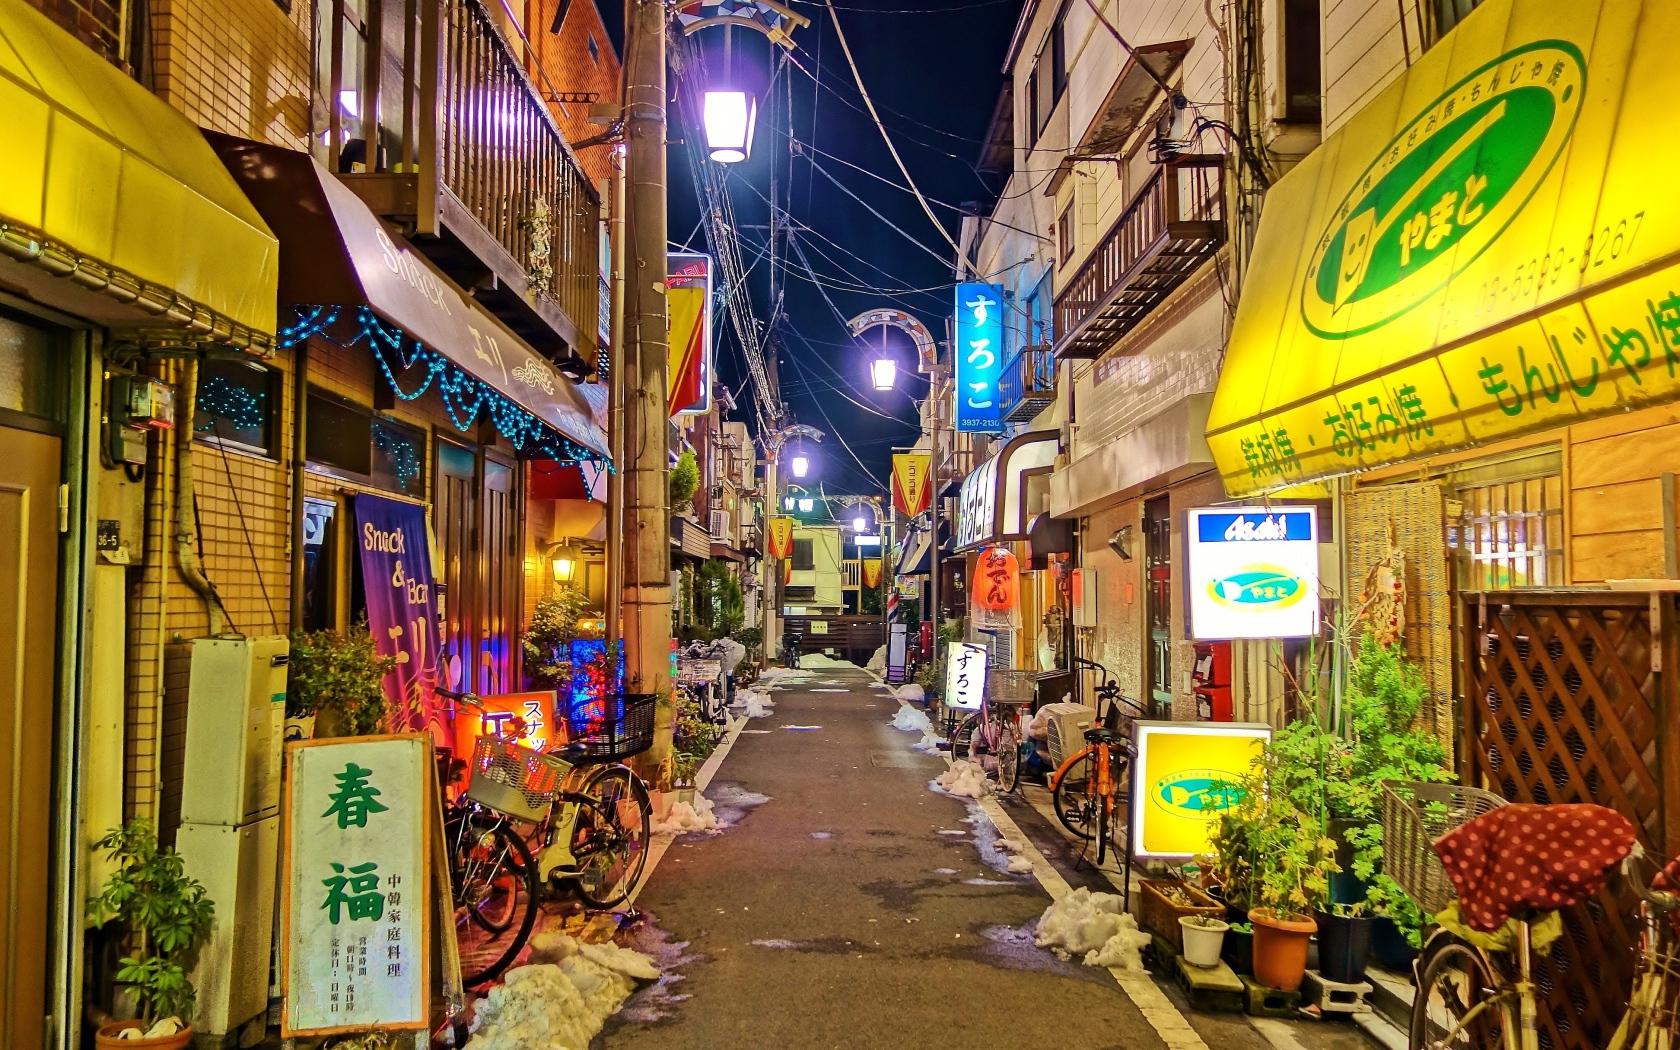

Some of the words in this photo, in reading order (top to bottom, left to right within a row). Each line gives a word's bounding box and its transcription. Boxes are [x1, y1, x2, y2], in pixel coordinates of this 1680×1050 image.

[1400, 174, 1489, 268] やまと
[375, 227, 452, 316] Snack
[467, 323, 508, 386] エリ
[965, 294, 997, 409] すろこ
[363, 521, 406, 555] Snack
[1224, 514, 1287, 541] Asahi
[392, 560, 406, 588] &
[407, 577, 429, 605] Bar
[986, 553, 1010, 604] おでん
[1251, 586, 1289, 600] やまと
[388, 616, 427, 676] エリ
[956, 653, 974, 705] すろこ
[523, 701, 548, 765] スナッ
[319, 762, 390, 925] 春福
[386, 873, 402, 978] 中韓家庭料理
